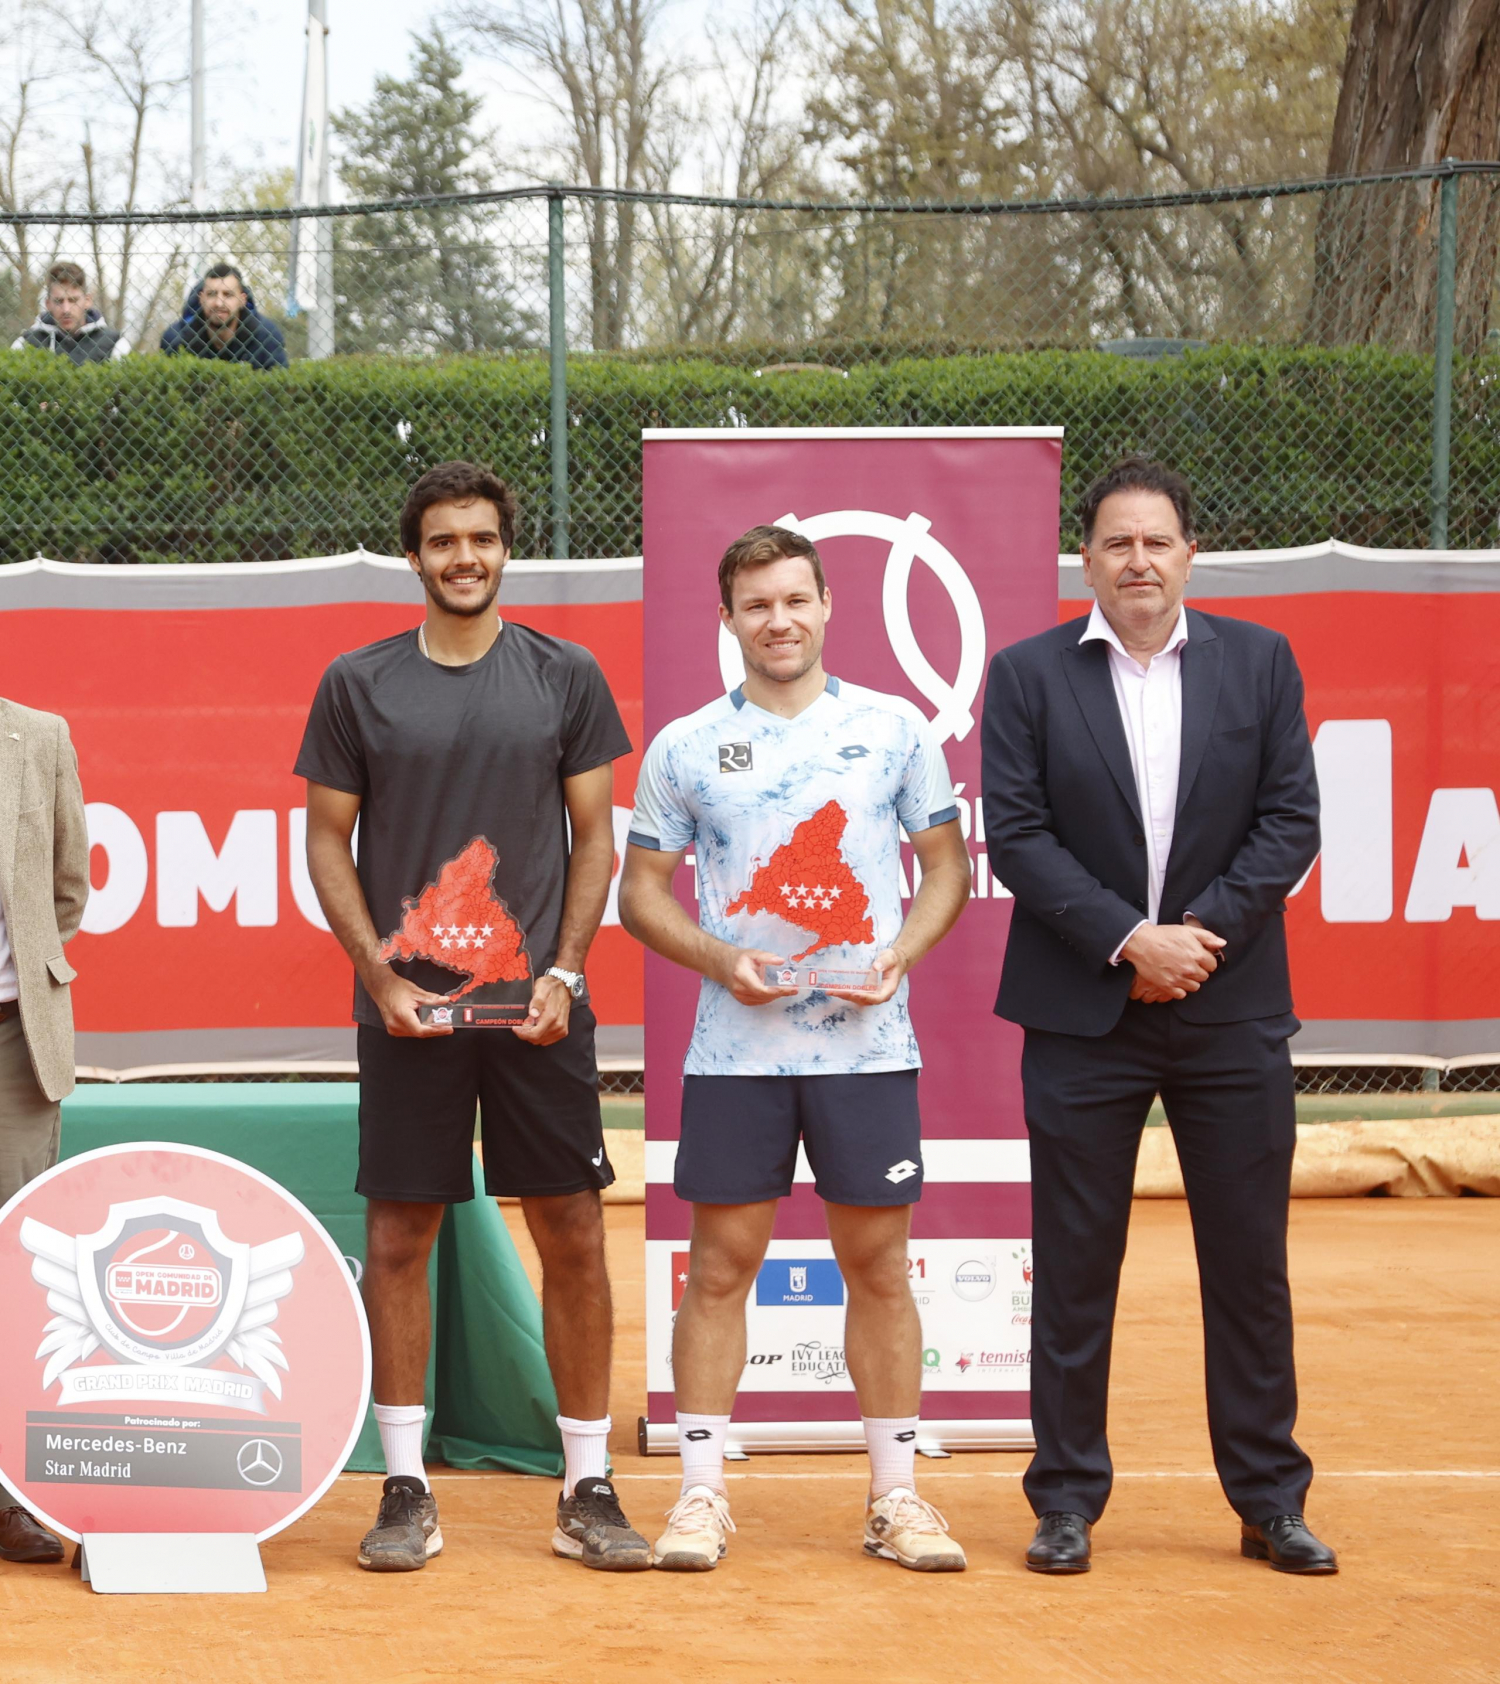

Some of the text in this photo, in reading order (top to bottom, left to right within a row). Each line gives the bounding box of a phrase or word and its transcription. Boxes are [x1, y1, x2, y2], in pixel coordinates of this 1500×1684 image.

[475, 1017, 506, 1025] CAMPEÓN
[157, 1272, 201, 1280] COMUNIDAD
[135, 1279, 214, 1299] MADRID
[783, 1294, 814, 1303] MADRID
[131, 1345, 161, 1360] Campo
[164, 1352, 186, 1360] Villa
[198, 1328, 224, 1351] Madrid
[791, 1350, 813, 1361] IVY
[74, 1374, 253, 1399] GRAND PRIX MADRID
[124, 1415, 201, 1429] Patrocinado por:
[46, 1434, 187, 1455] Mercedes-Benz
[45, 1460, 131, 1478] Star Madrid
